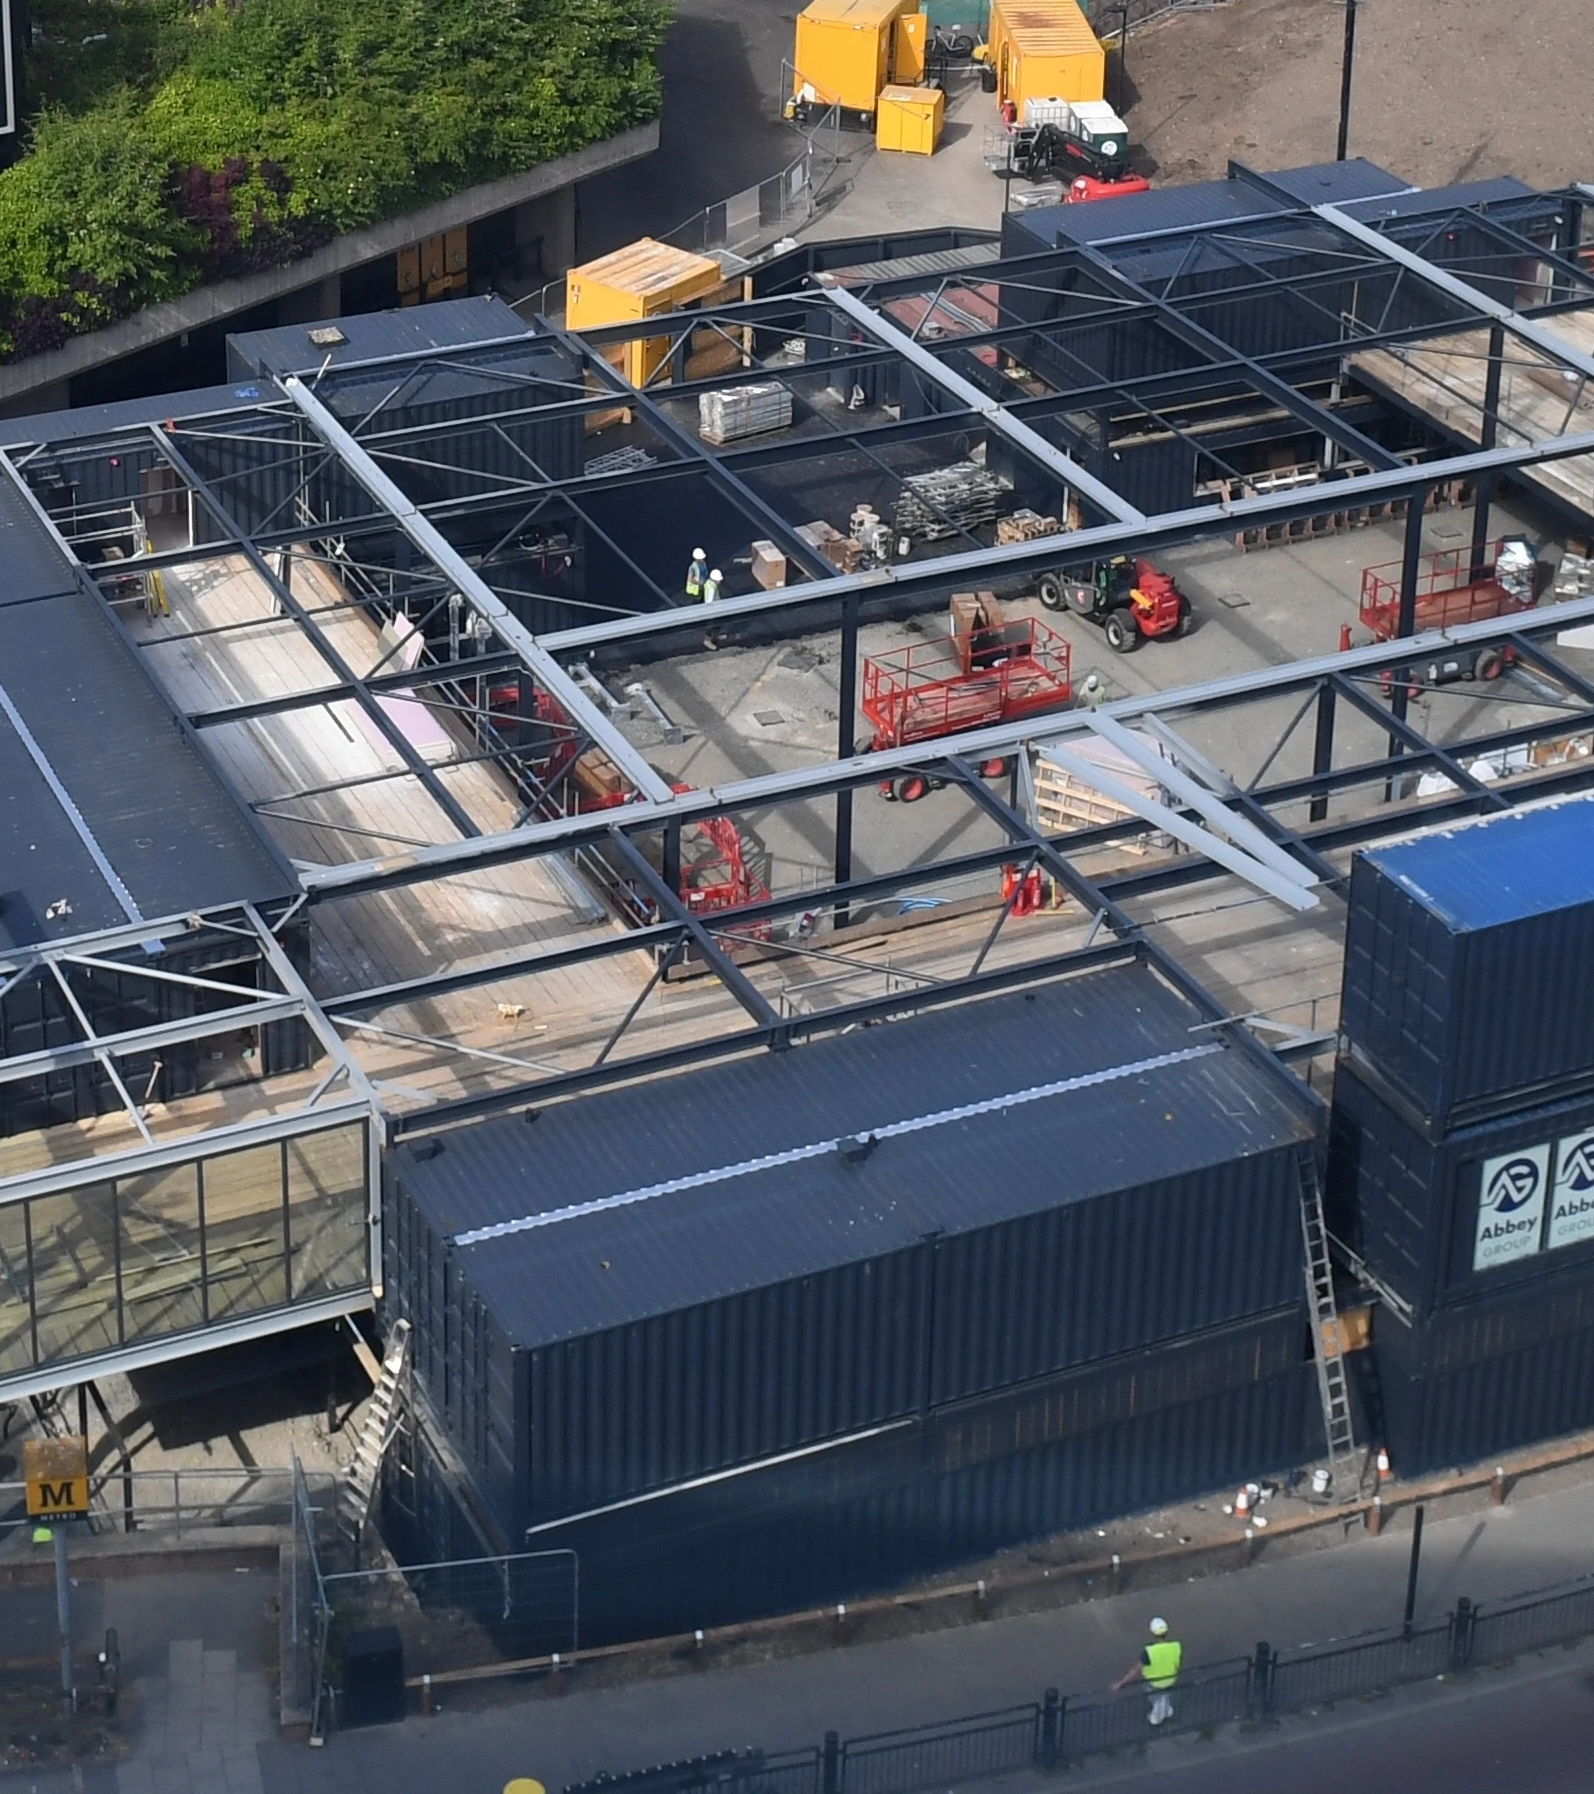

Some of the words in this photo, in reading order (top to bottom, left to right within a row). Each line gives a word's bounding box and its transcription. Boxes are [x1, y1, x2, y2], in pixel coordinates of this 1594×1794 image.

[1479, 1216, 1538, 1242] Abbey
[1482, 1236, 1531, 1258] GROUP
[38, 1481, 75, 1508] M
